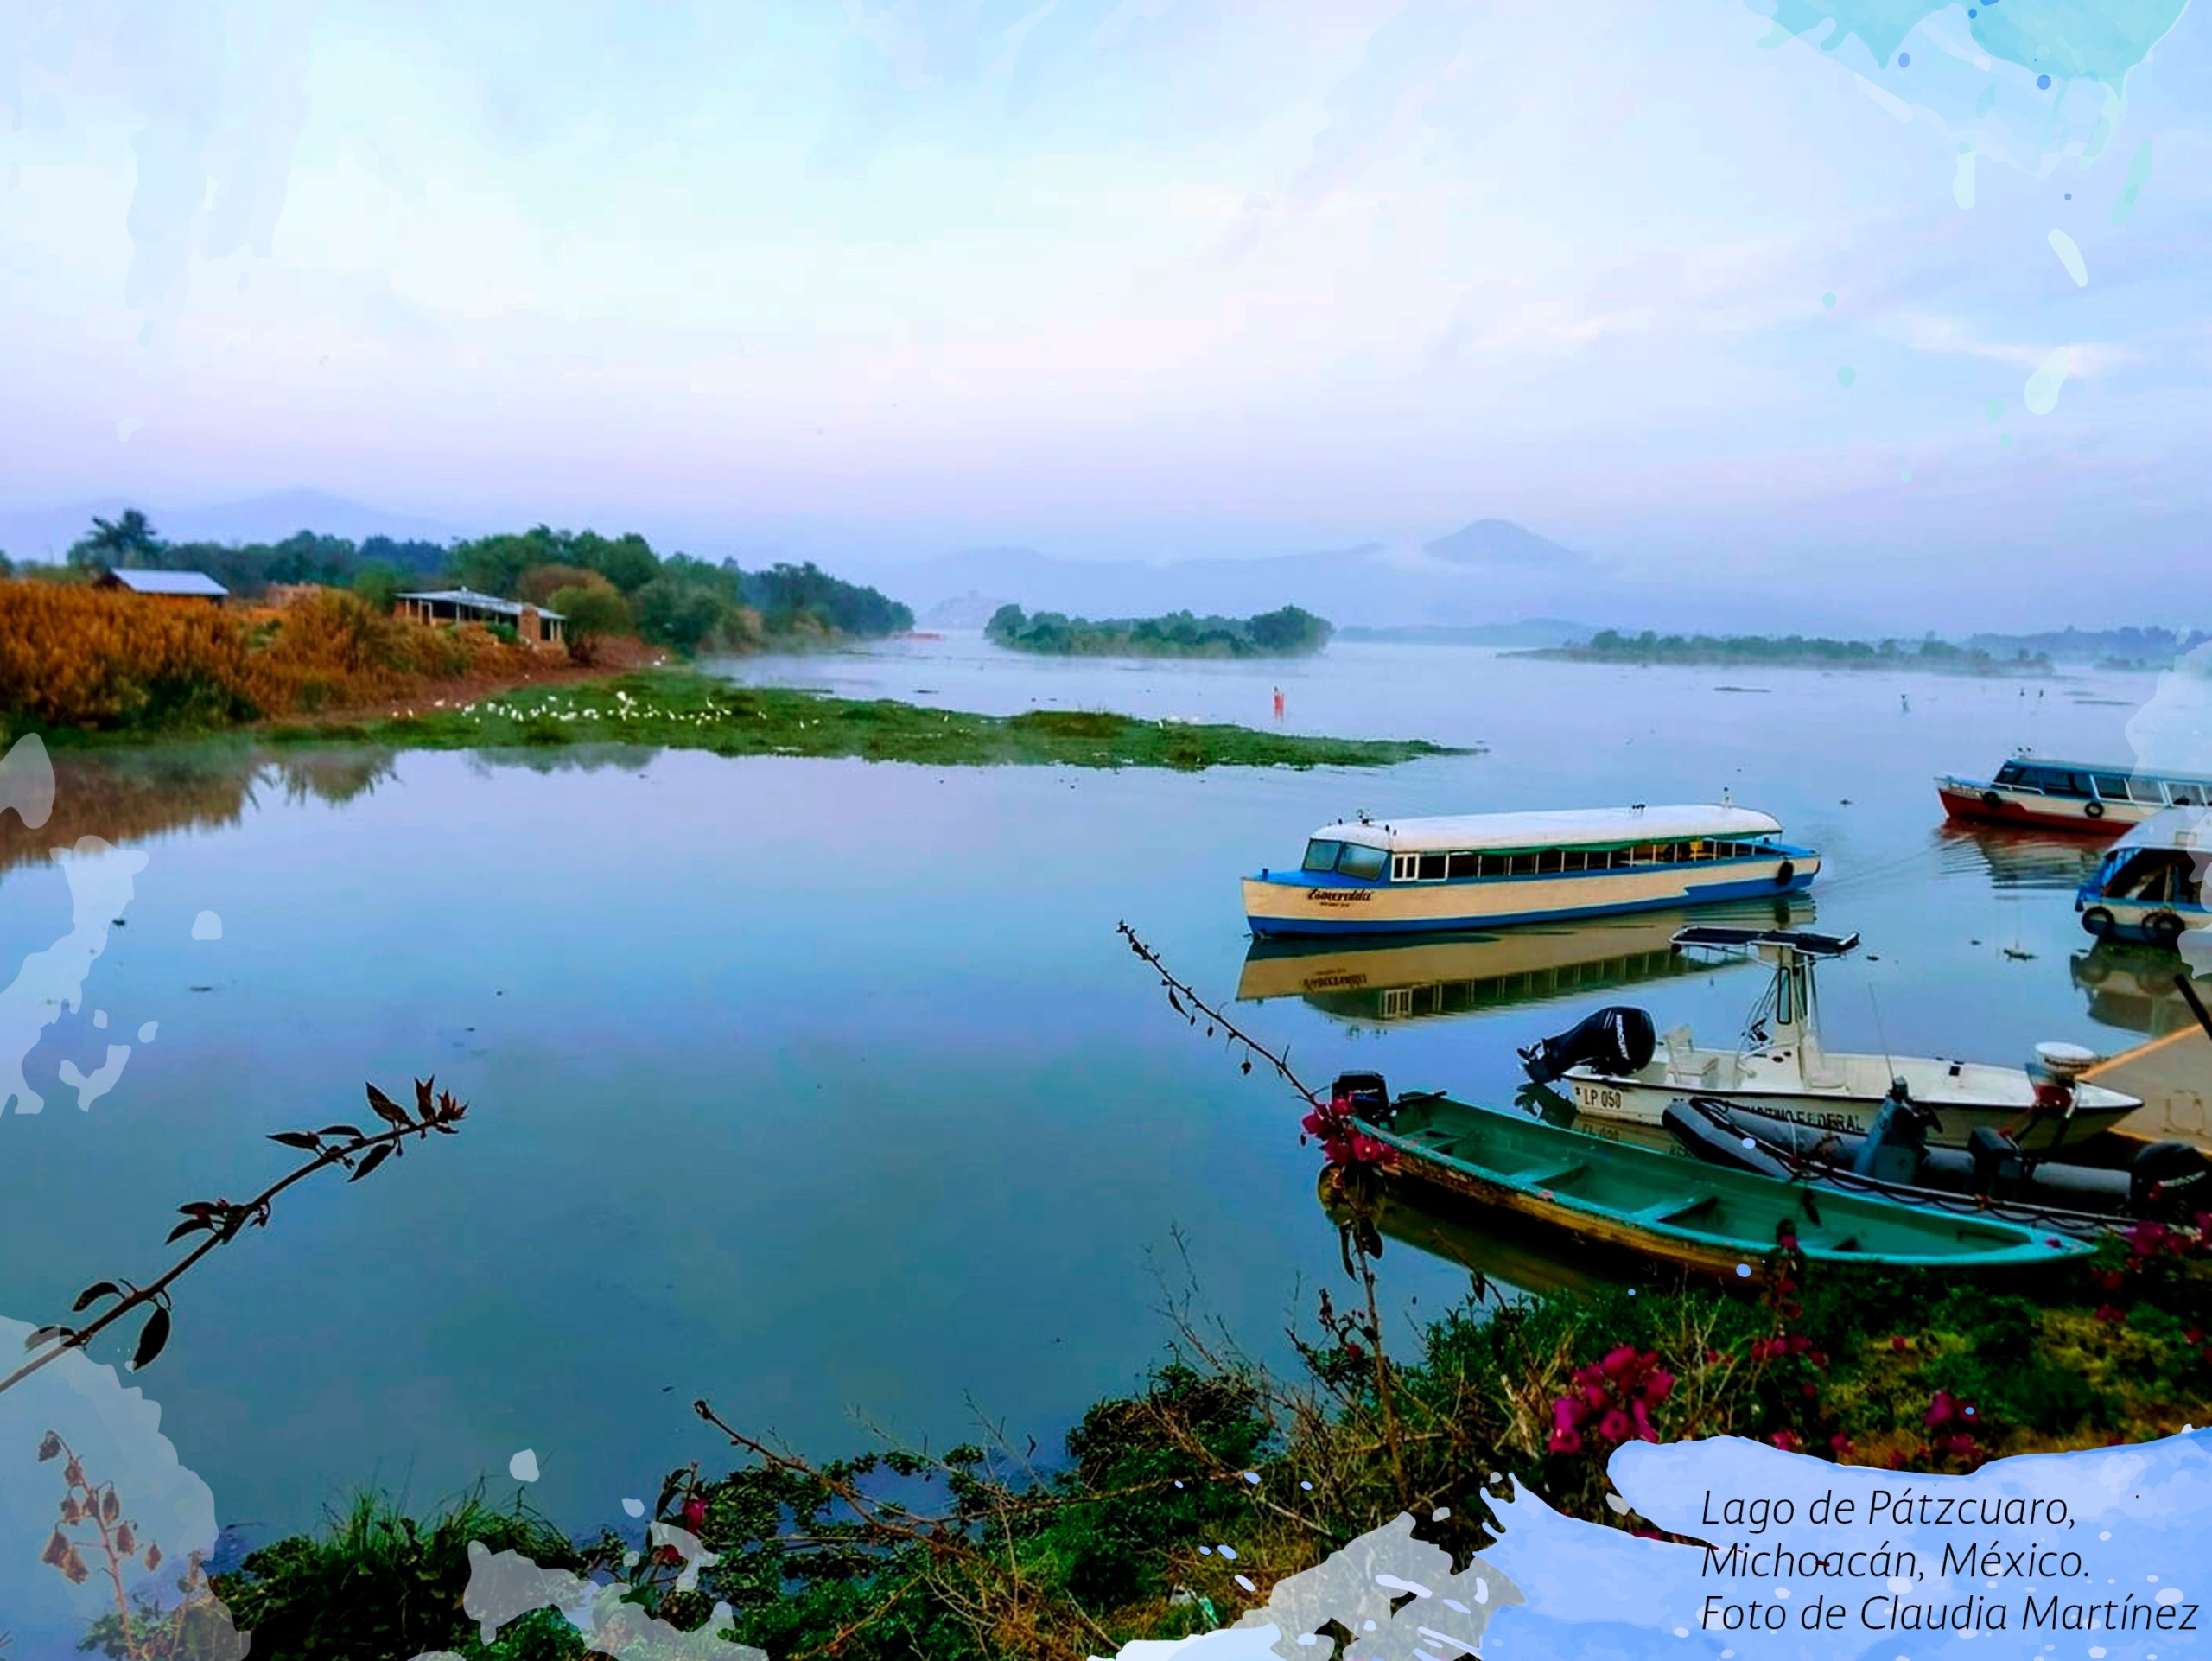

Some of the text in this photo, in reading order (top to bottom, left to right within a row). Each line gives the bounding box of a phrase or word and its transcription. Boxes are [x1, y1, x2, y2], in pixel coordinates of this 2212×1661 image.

[1584, 1088, 1621, 1109] LP 050
[1796, 1111, 1866, 1132] FEDERAL
